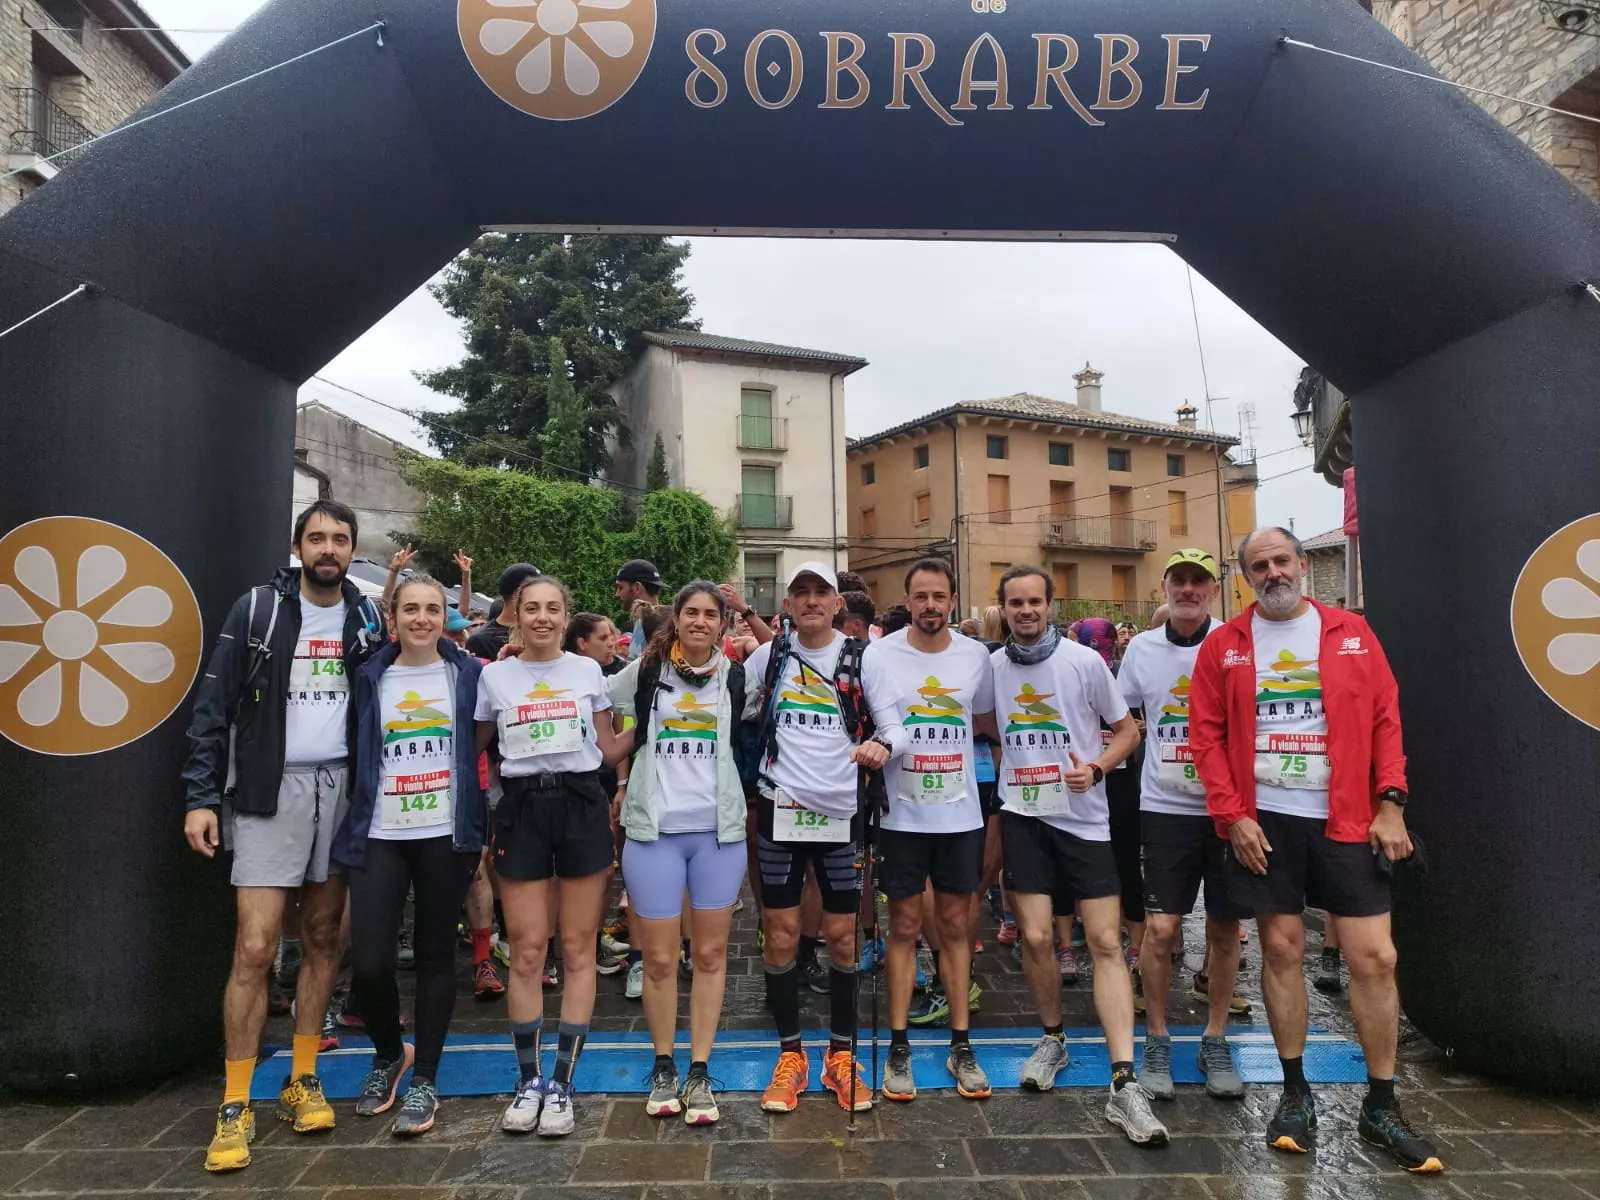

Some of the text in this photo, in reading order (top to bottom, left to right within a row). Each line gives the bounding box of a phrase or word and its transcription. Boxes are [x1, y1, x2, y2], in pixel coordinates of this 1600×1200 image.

[971, 0, 1007, 13] de
[684, 28, 1212, 126] SOBRARBE
[311, 660, 345, 676] 143
[528, 721, 556, 739] 30
[1271, 740, 1277, 750] O
[1278, 740, 1300, 751] viento
[1279, 755, 1308, 773] 75
[922, 774, 944, 789] 61
[1022, 786, 1040, 802] 87
[400, 793, 438, 813] 142
[795, 810, 829, 826] 132
